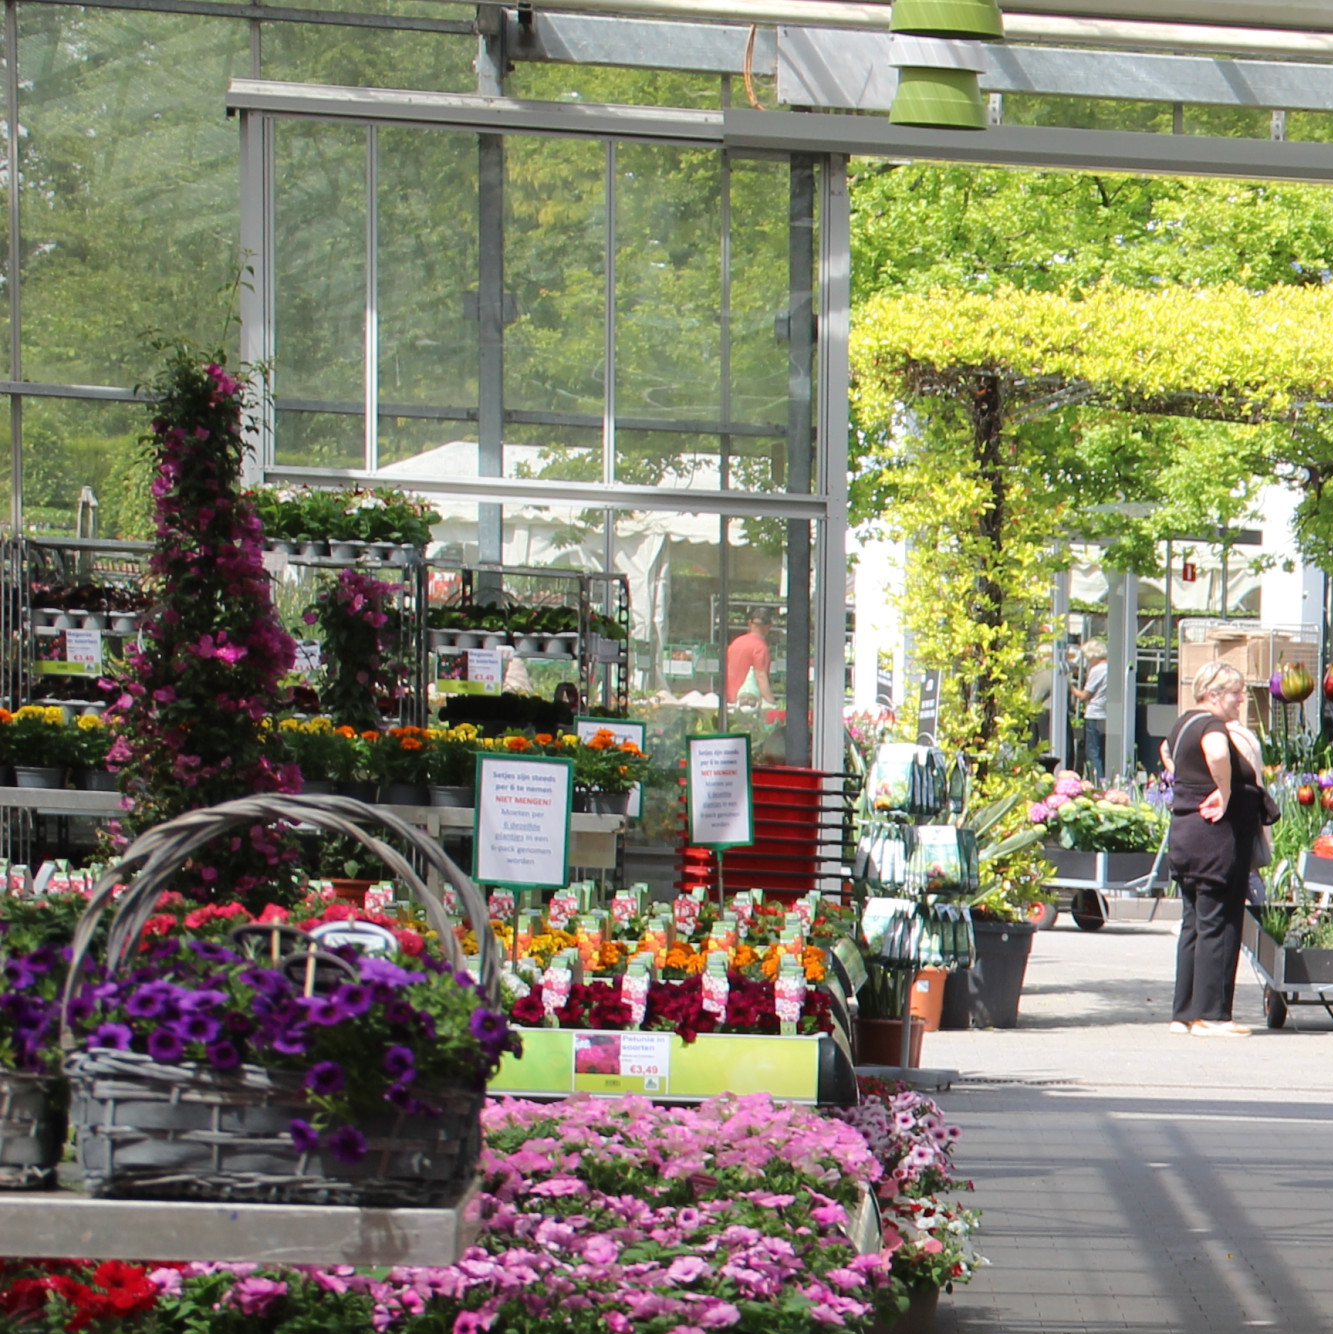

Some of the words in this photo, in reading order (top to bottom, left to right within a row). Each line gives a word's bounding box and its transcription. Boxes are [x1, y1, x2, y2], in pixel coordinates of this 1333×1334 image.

[493, 772, 515, 780] Setjes
[517, 773, 530, 781] zijn
[532, 774, 556, 782] steeds
[495, 784, 508, 792] per
[495, 795, 512, 803] NIET
[515, 797, 552, 806] MENGEN!
[532, 811, 544, 819] per
[622, 1034, 655, 1042] Petunia
[630, 1065, 659, 1076] €3,49
